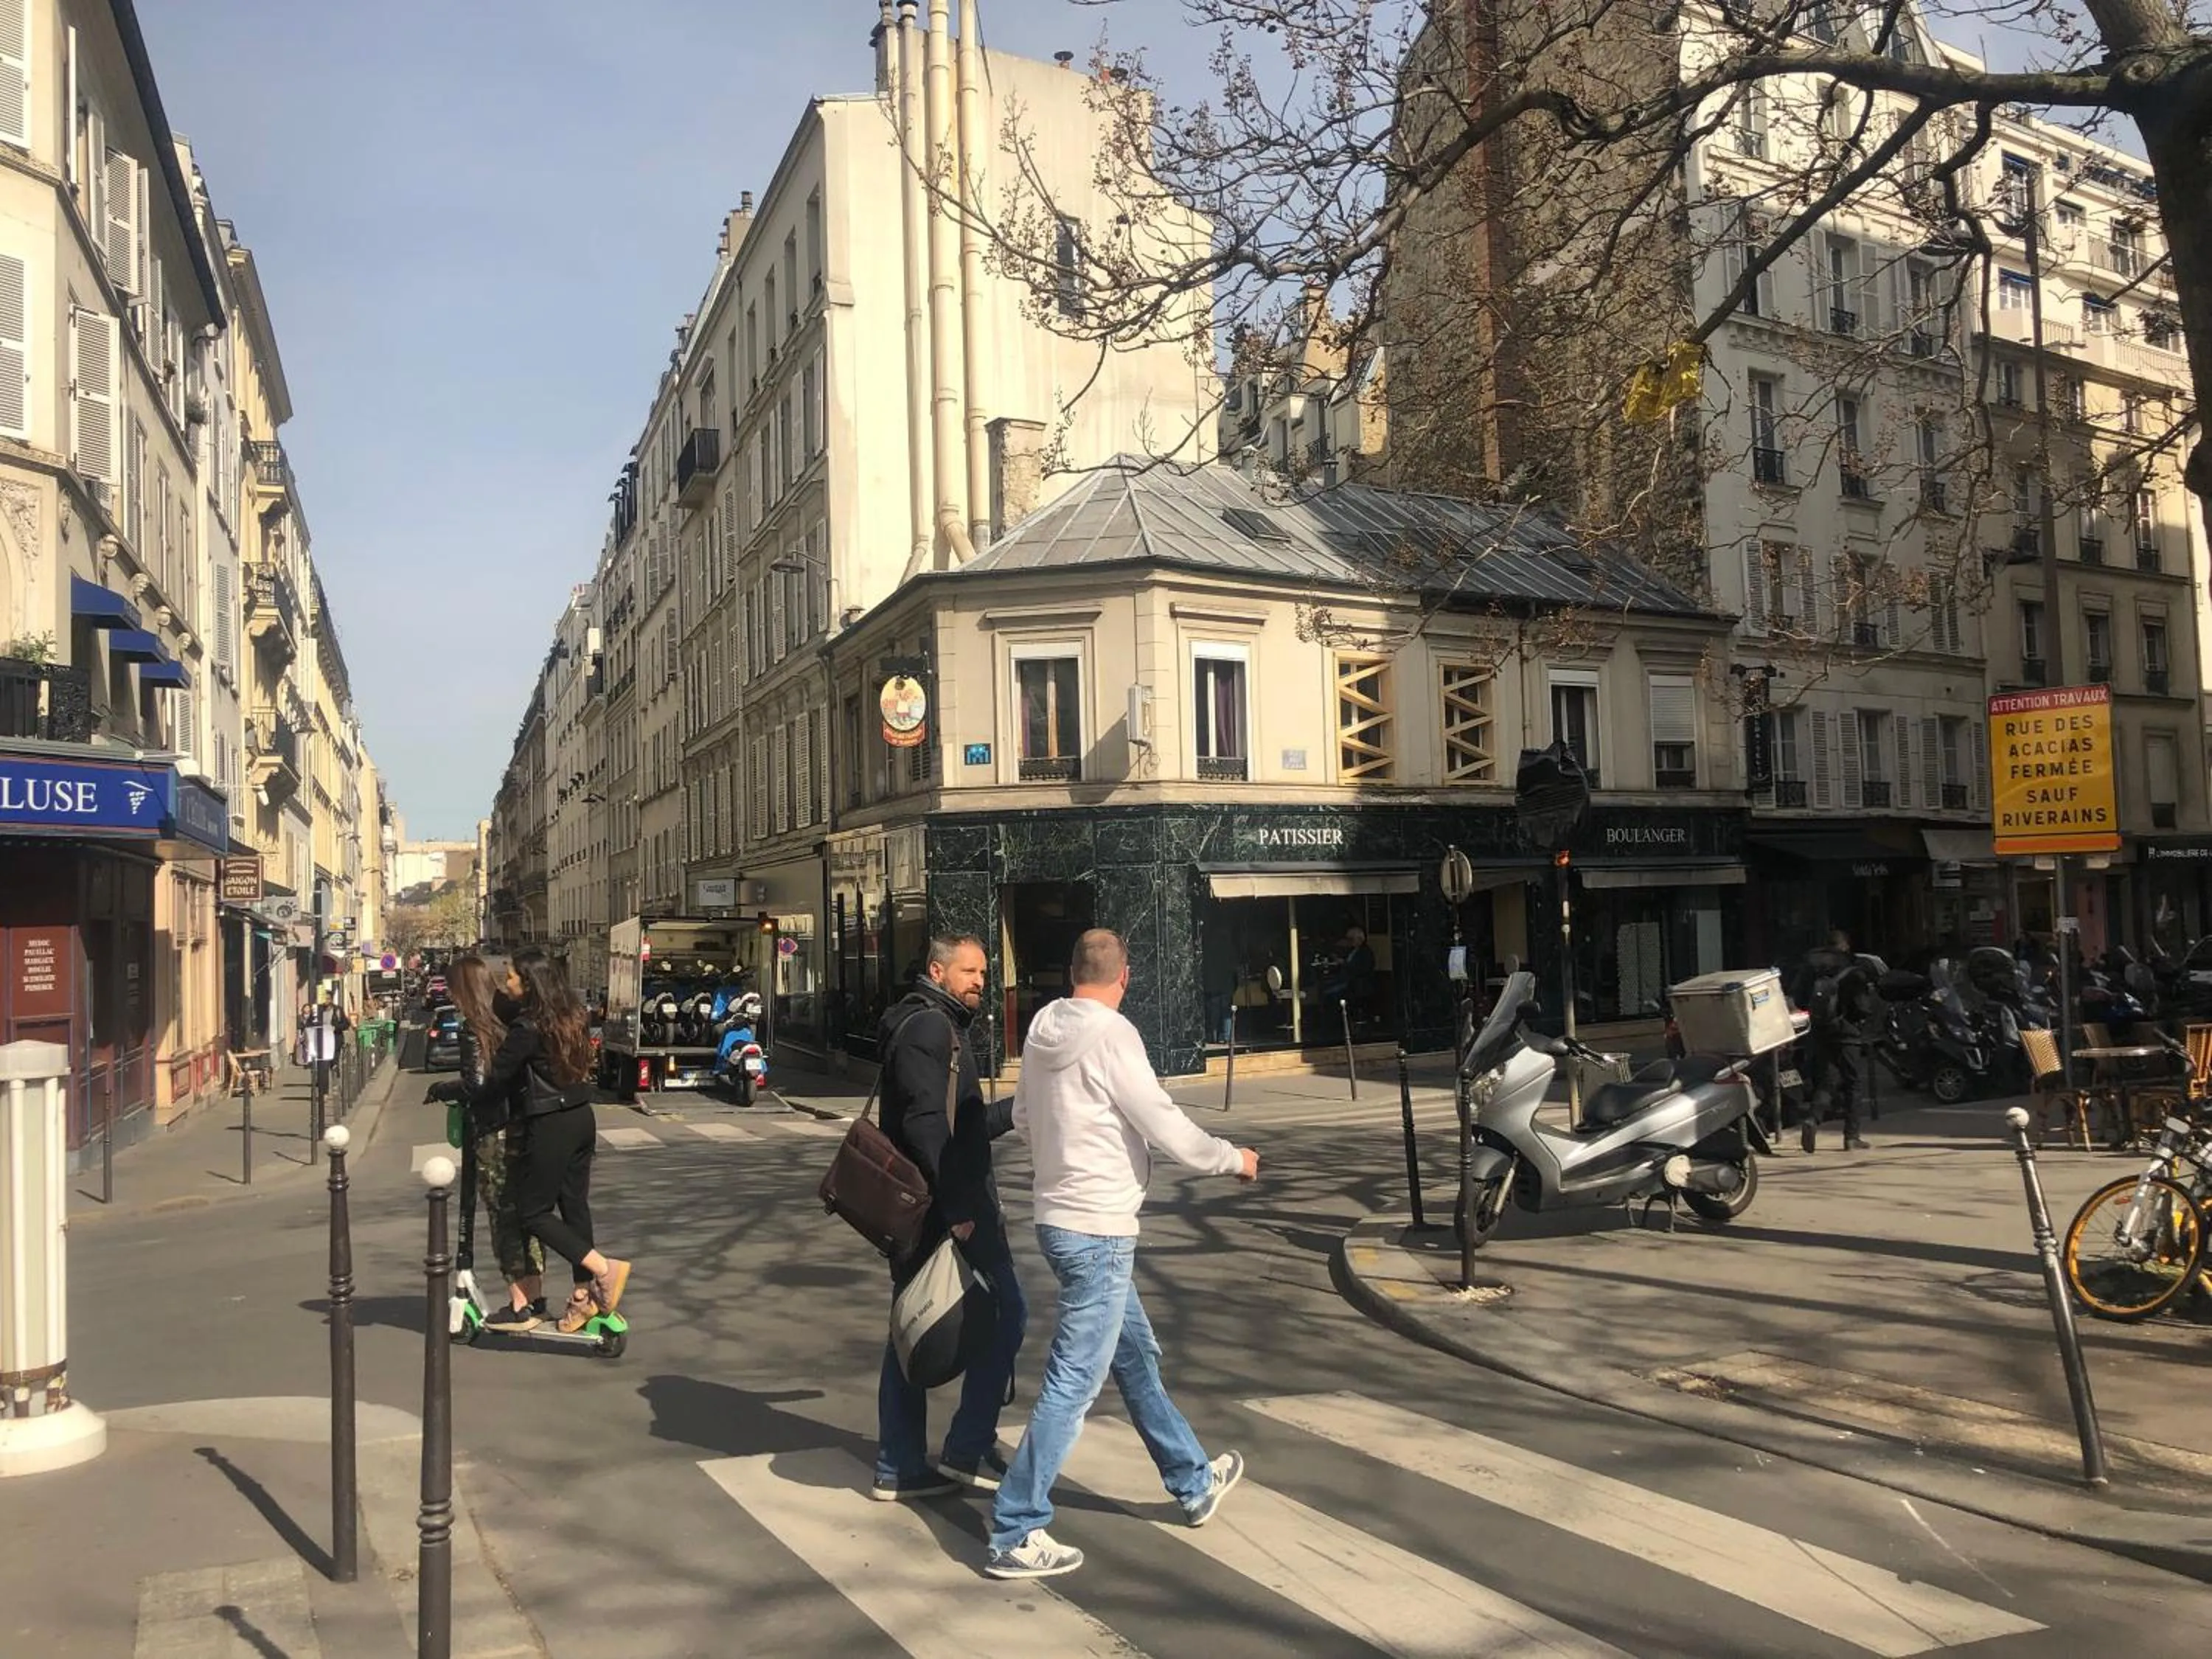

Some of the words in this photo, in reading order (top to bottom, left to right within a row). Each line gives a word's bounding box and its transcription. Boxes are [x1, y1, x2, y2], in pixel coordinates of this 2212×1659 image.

[1991, 695, 2050, 712] ATTENTION
[2053, 689, 2107, 703] TRAVAUX
[2005, 720, 2043, 736] RUE
[2055, 714, 2094, 732] DES
[2008, 737, 2093, 757] ACACIAS
[2010, 758, 2093, 779] FERMÉE
[0, 776, 98, 813] LUSE
[2027, 787, 2079, 804] SAUF
[2002, 807, 2107, 827] RIVERAINS
[1259, 828, 1343, 845] PATISSIER
[1606, 827, 1686, 844] BOULANGER
[225, 877, 257, 886] SAIGON
[226, 886, 255, 896] ETOILE
[1034, 1550, 1052, 1567] N
